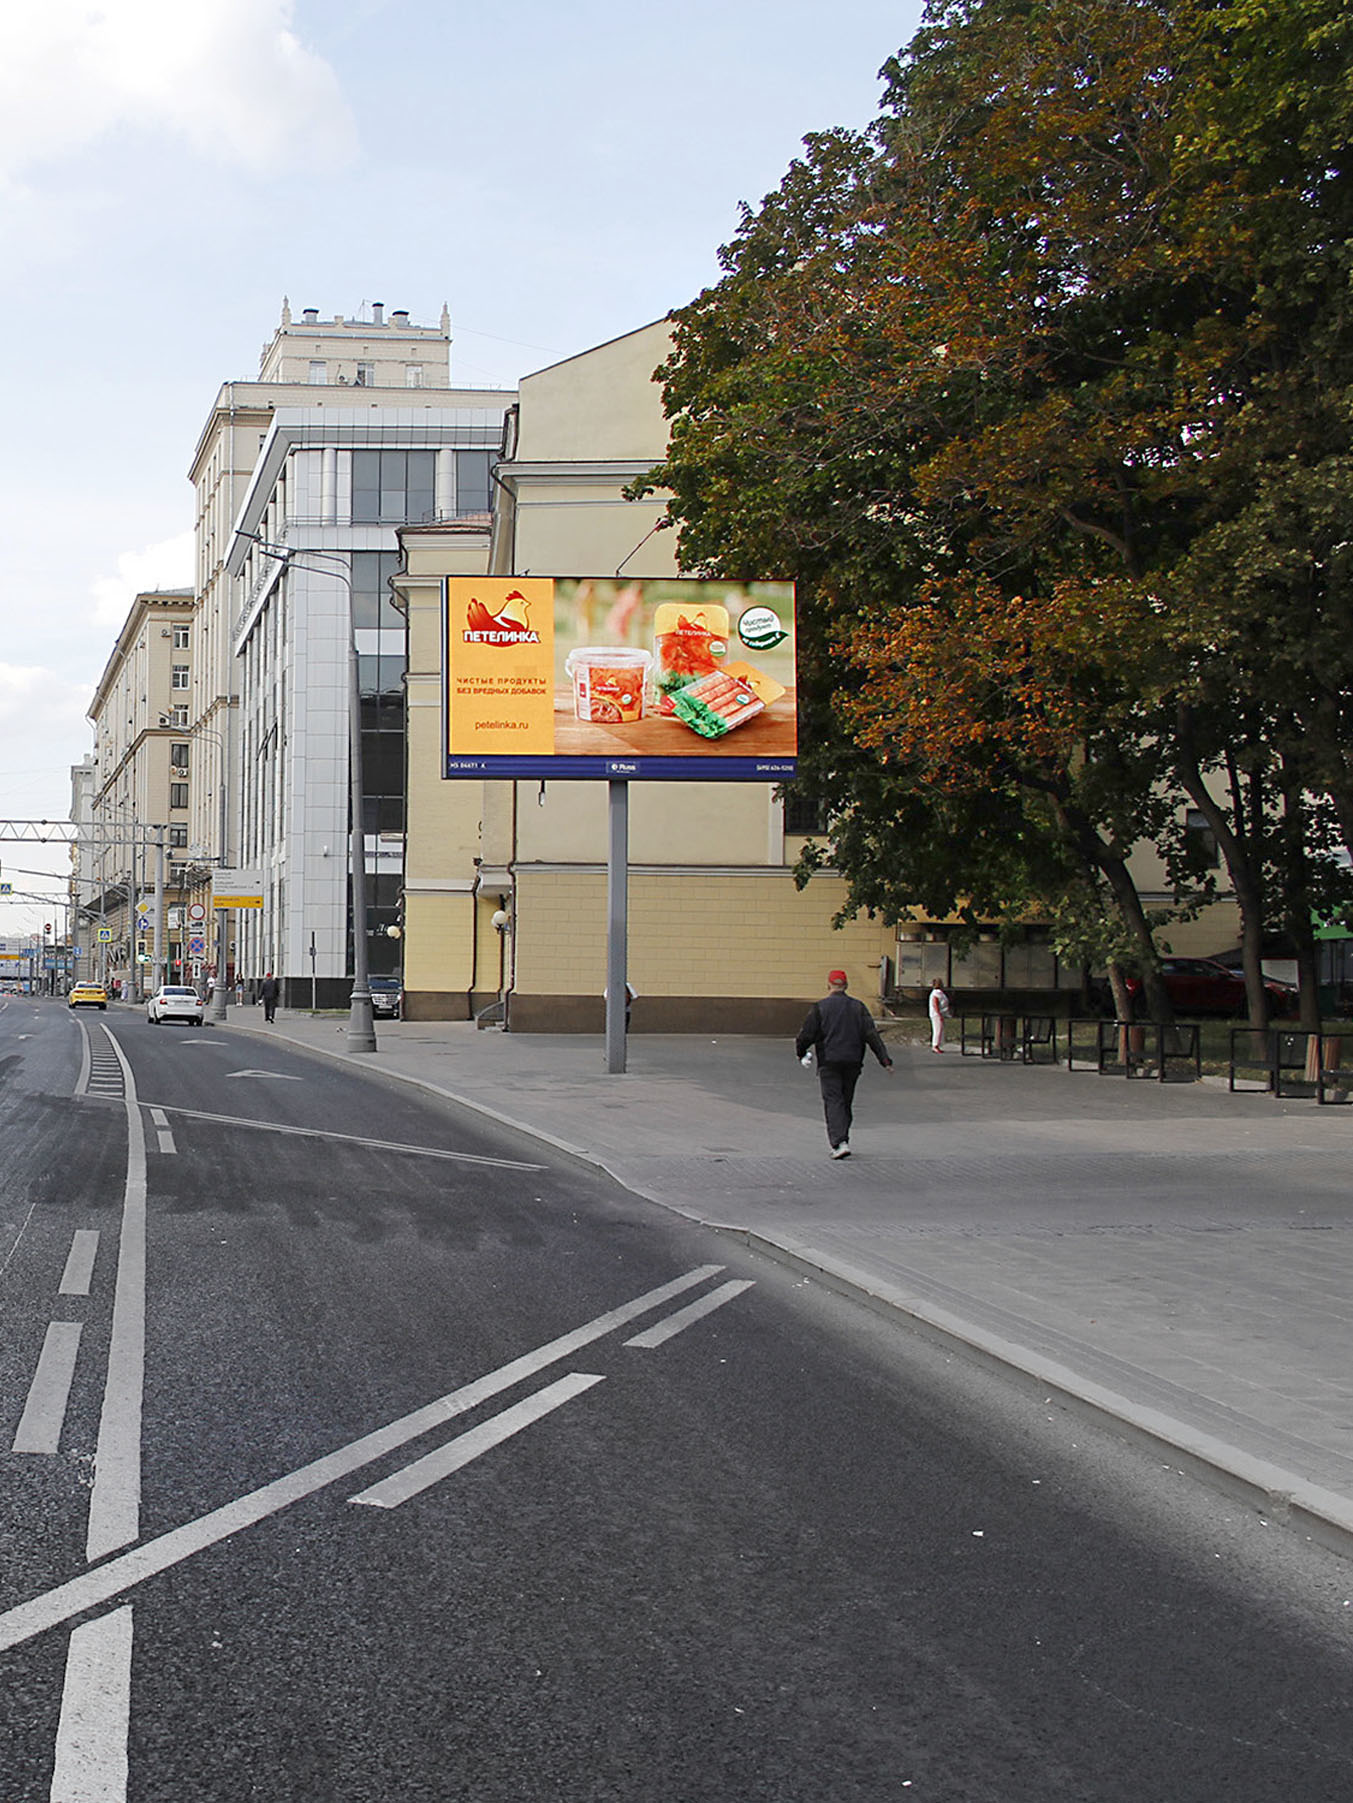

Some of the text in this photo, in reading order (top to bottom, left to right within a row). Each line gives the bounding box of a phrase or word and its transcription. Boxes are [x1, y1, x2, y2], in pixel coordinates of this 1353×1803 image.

[463, 630, 540, 643] ПЕТЕЛИНКА
[456, 677, 547, 686] ЧИСТЫЕ ПРОДУКТЫ
[456, 687, 547, 695] БЕЗ ВРЕДНЫХ ДОБАВОК
[474, 721, 529, 731] petelinka.ru
